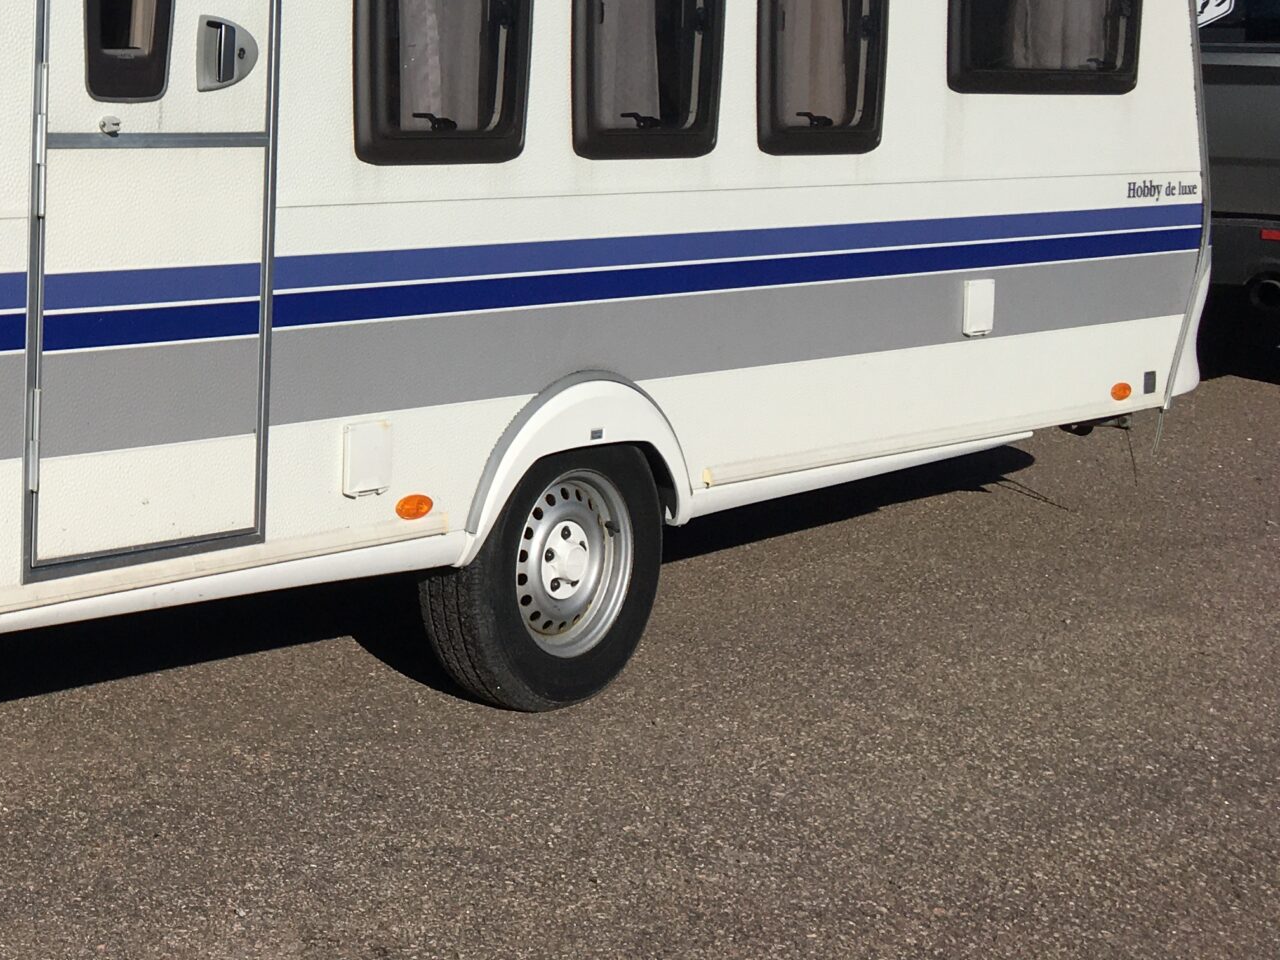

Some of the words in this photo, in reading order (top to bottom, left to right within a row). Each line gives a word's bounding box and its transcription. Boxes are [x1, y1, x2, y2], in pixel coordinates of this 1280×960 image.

[1127, 180, 1162, 202] Hobby
[1165, 181, 1176, 196] de
[1178, 181, 1197, 196] luxe
